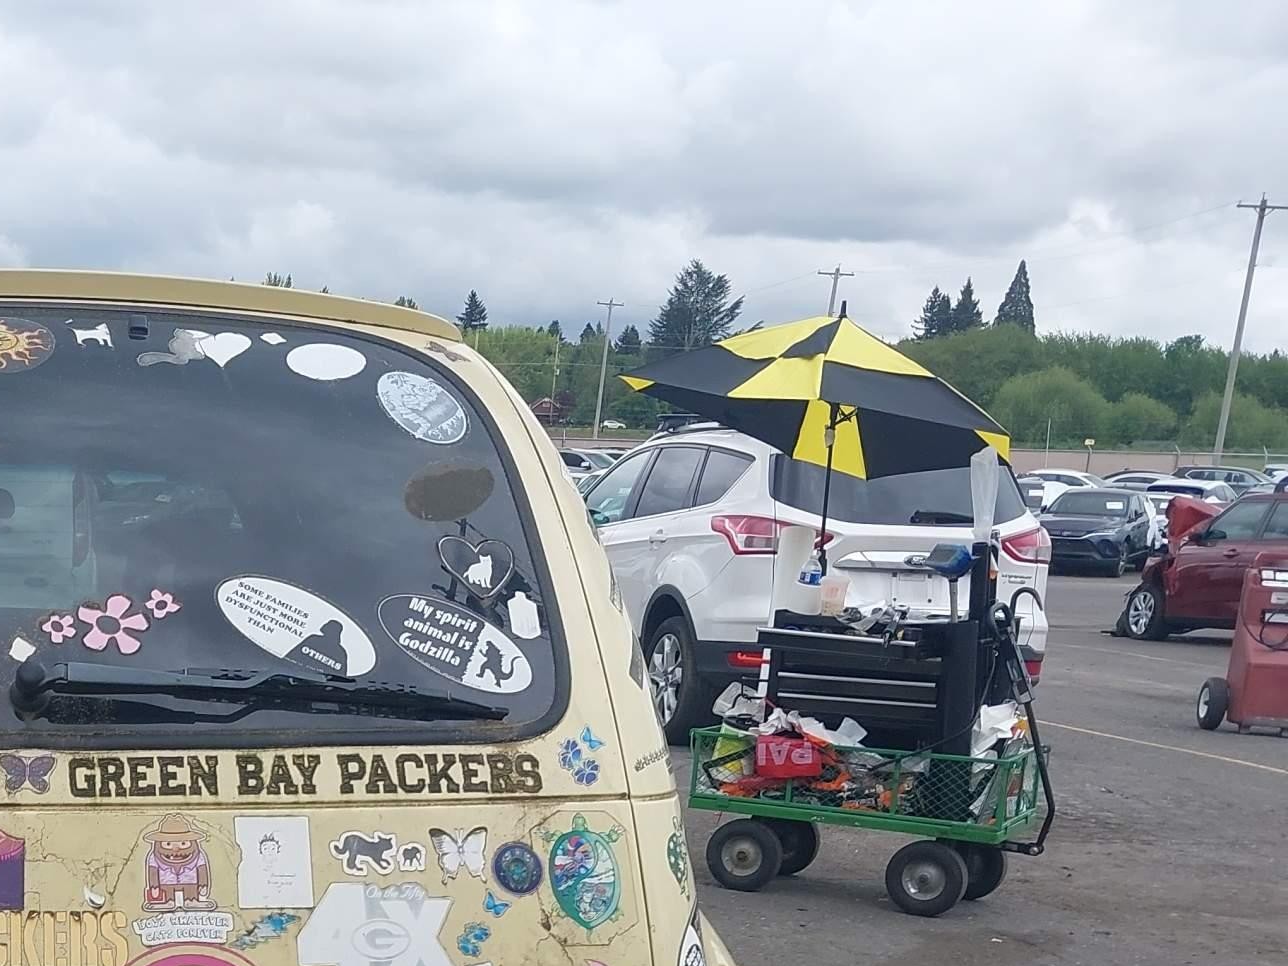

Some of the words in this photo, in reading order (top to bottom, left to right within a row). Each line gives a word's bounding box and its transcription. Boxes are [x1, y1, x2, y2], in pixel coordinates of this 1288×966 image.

[224, 596, 305, 639] DYSFUNCTIONAL
[231, 589, 253, 604] ARE
[253, 598, 279, 615] JUST
[278, 610, 307, 629] MORE
[237, 581, 265, 598] SOME
[266, 594, 310, 619] FAMILIES
[408, 597, 435, 619] My
[434, 609, 478, 633] spirit
[247, 616, 275, 635] THAN
[403, 617, 457, 645] animal
[457, 636, 473, 651] is
[301, 646, 342, 670] OTHERS
[398, 632, 461, 666] Godzilla
[68, 754, 219, 798] GREEN
[235, 753, 321, 796] BAY
[336, 753, 543, 794] PACKERS
